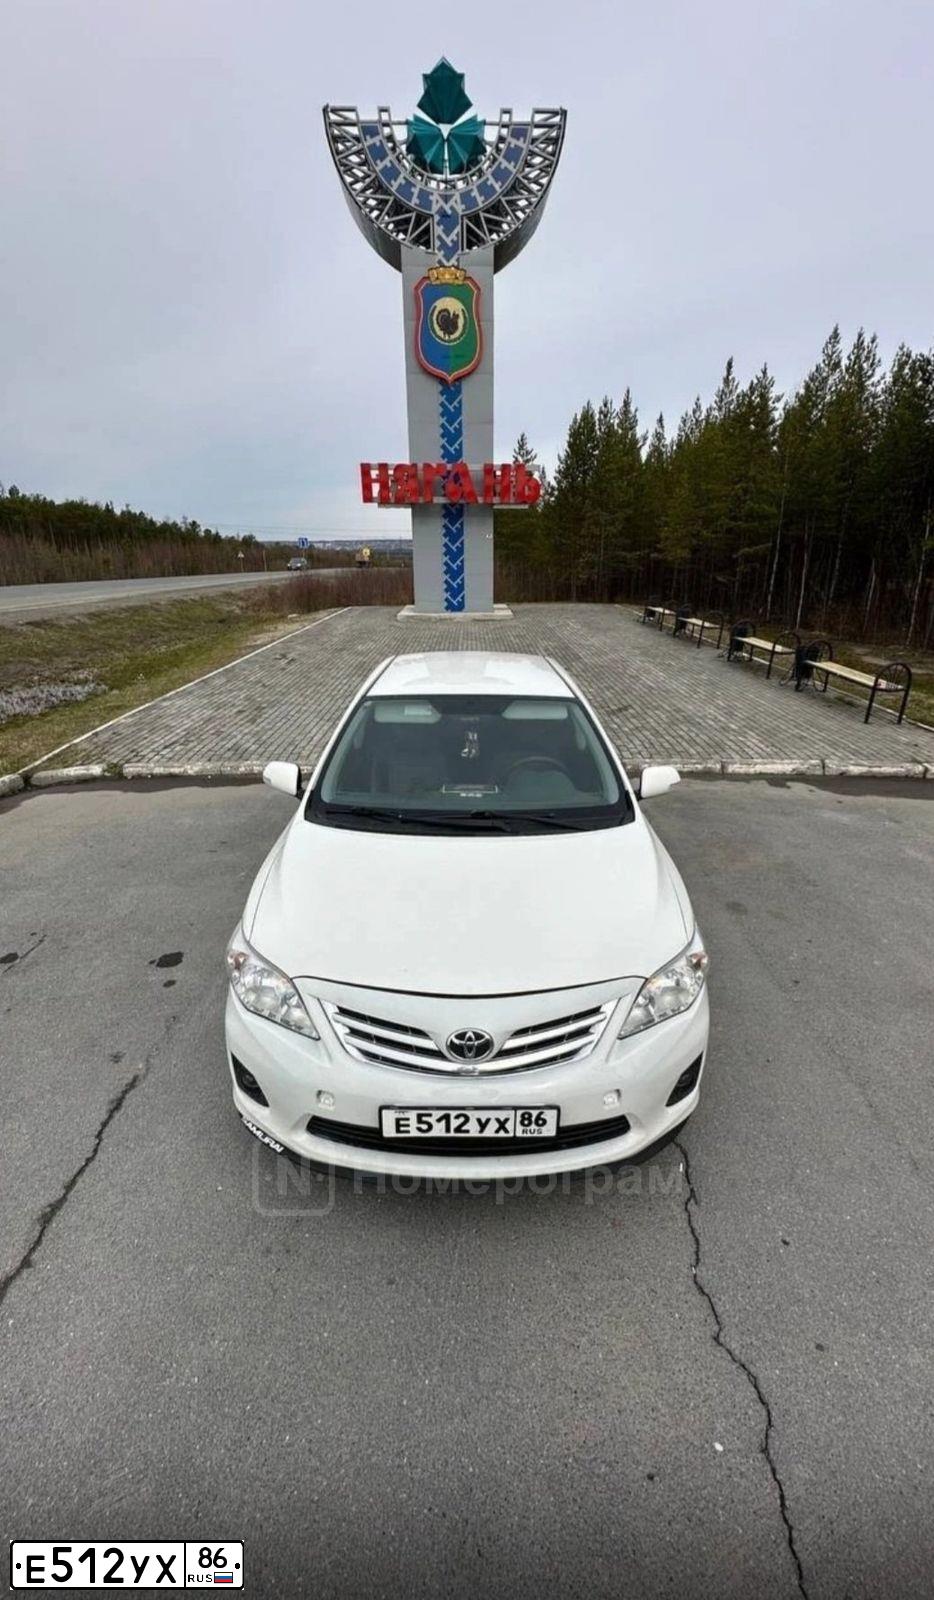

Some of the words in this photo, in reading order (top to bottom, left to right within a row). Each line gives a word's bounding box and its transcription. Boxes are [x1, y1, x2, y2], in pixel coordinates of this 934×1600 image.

[360, 462, 541, 504] НЯГАНЬ
[394, 1112, 510, 1134] Е512УХ
[519, 1111, 548, 1128] 86
